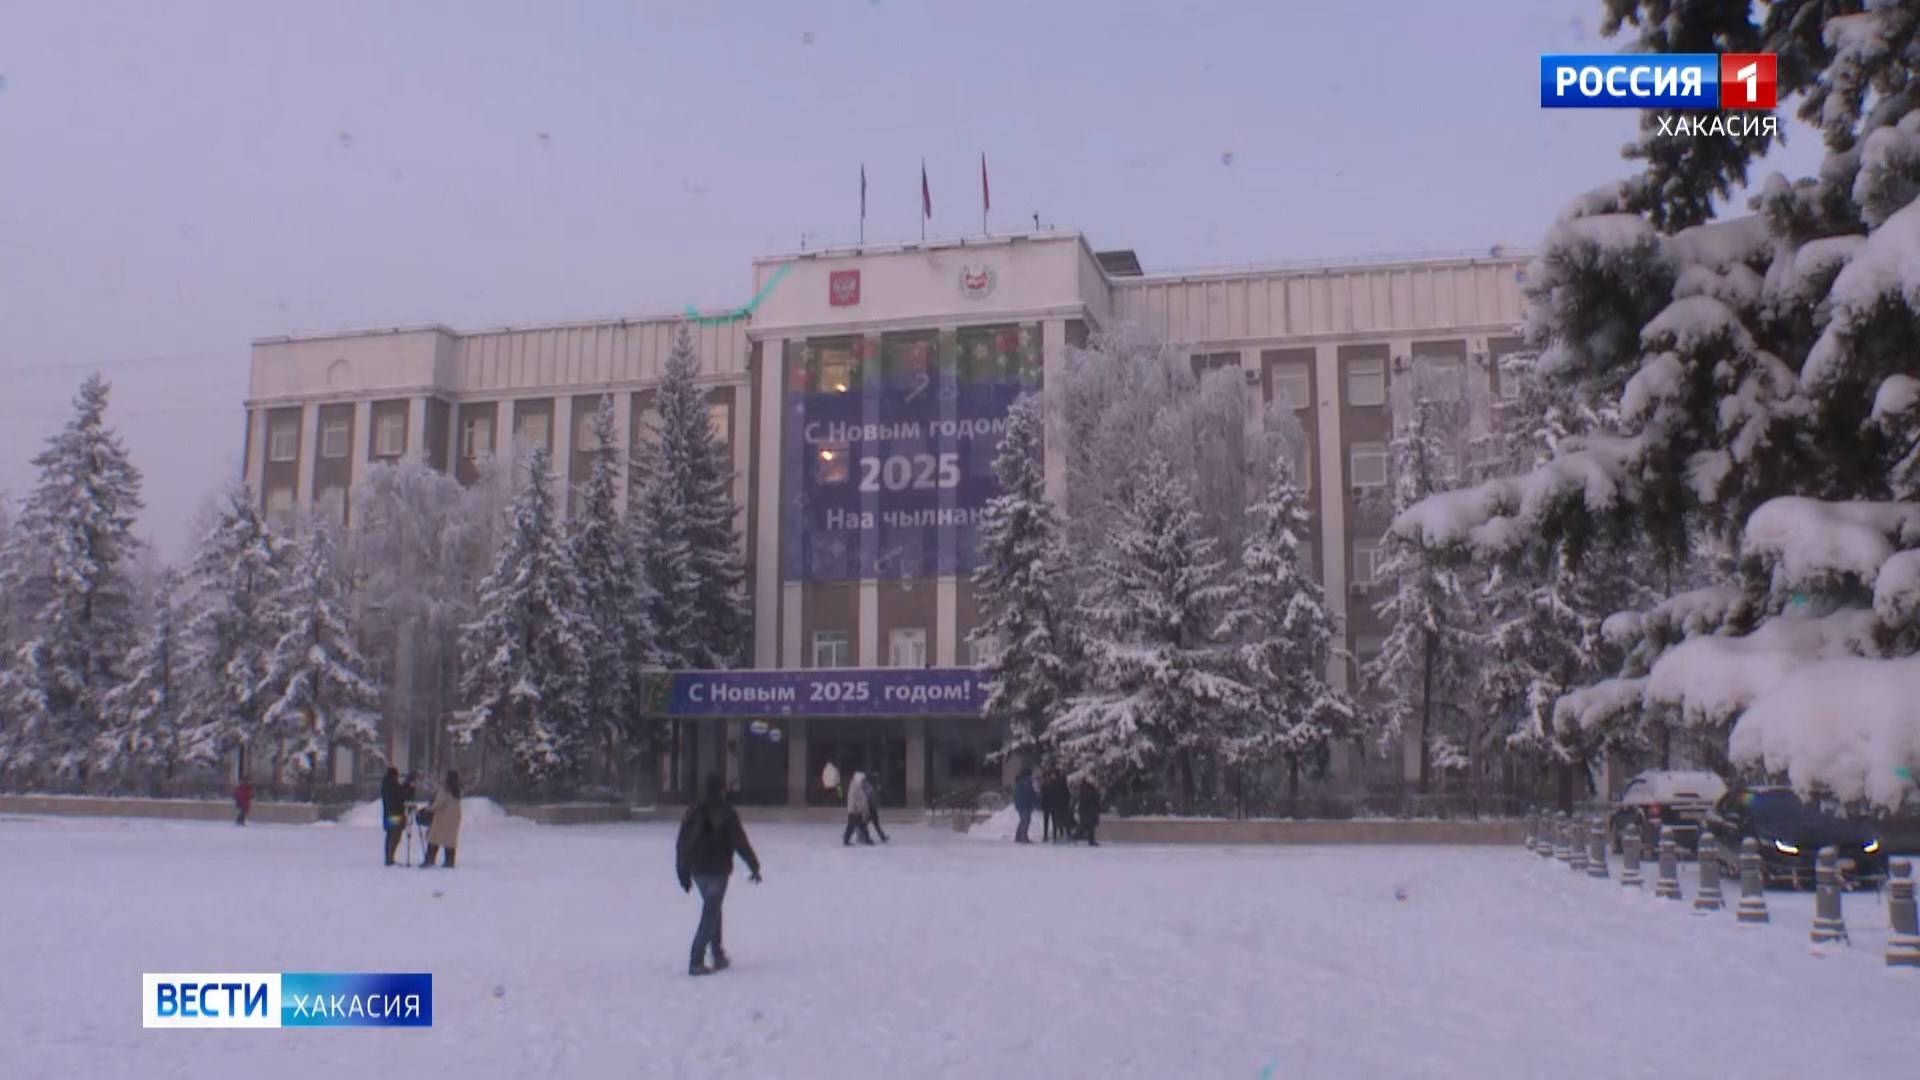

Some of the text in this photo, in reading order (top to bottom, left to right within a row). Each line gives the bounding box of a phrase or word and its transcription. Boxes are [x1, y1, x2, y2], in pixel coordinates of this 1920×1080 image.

[804, 423, 820, 443] С
[828, 421, 920, 443] Новым
[859, 453, 961, 492] 2025
[826, 509, 874, 530] Наа
[688, 680, 971, 703] С Новым 2025 годом!
